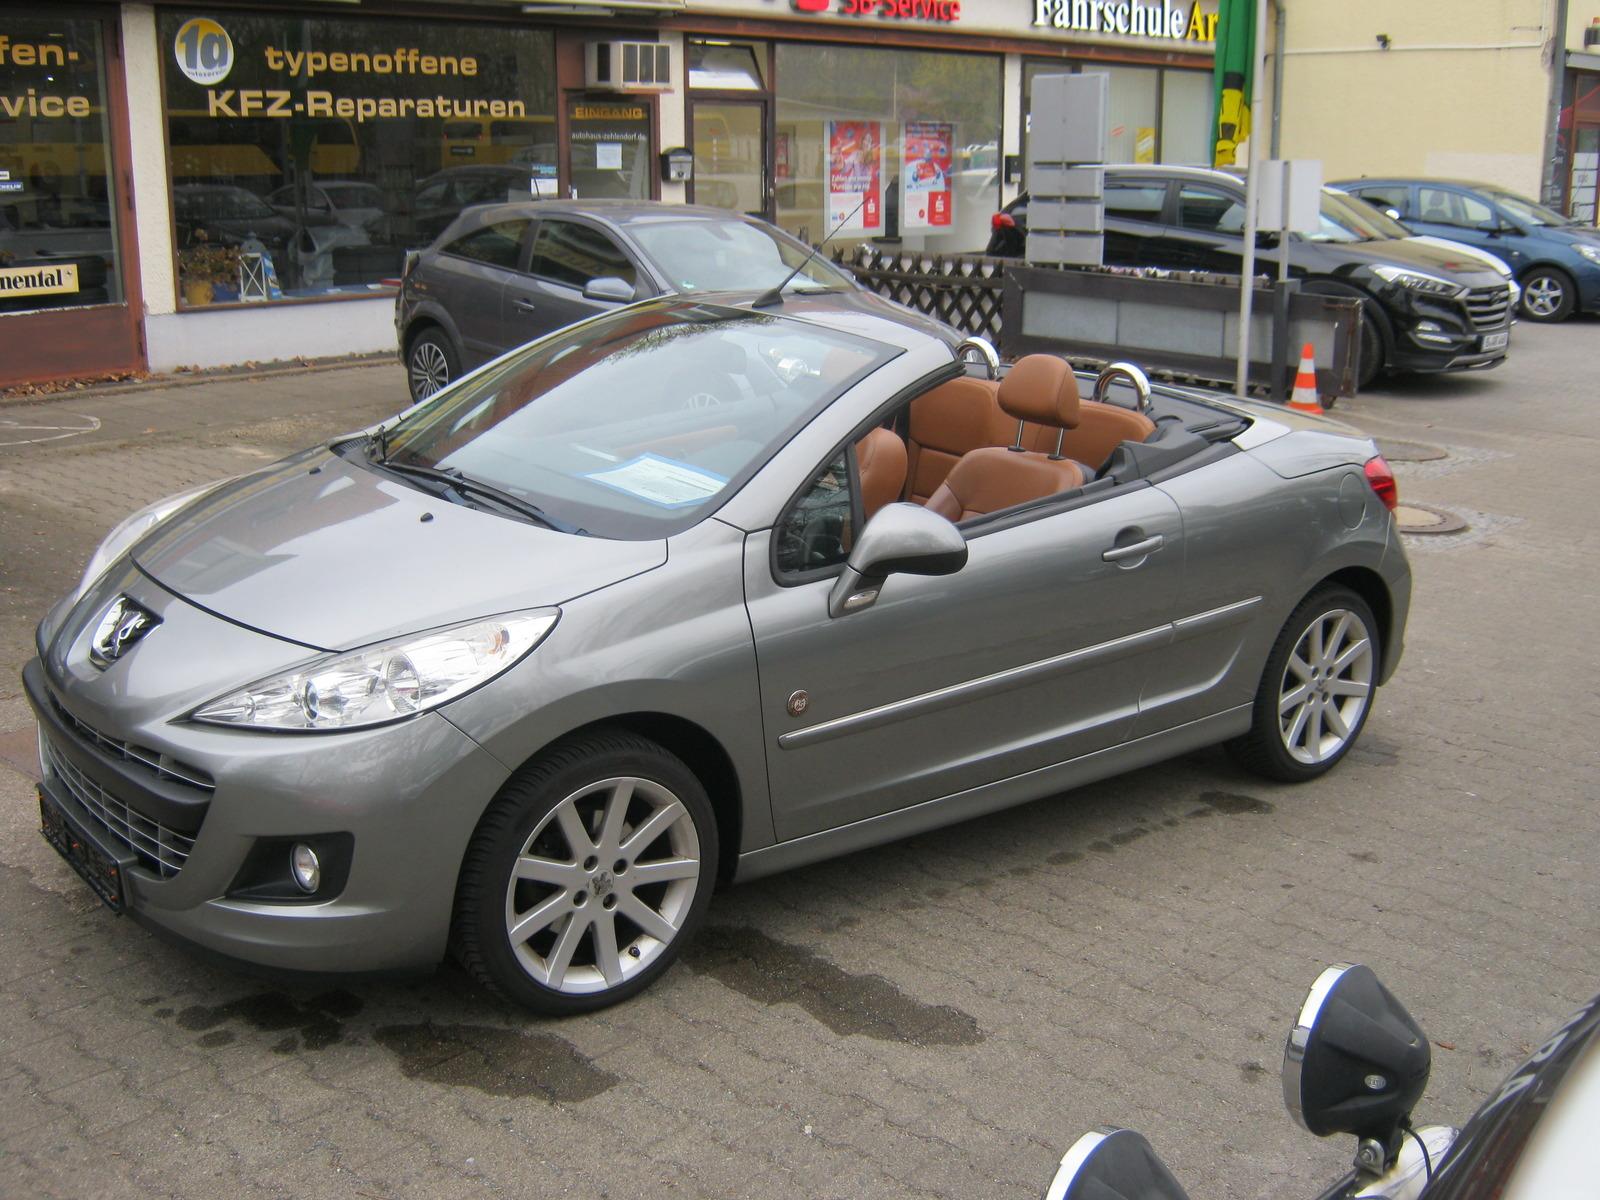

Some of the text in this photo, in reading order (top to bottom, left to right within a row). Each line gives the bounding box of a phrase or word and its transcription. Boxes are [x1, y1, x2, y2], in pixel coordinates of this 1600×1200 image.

[842, 0, 961, 21] SB-Service
[1034, 0, 1184, 39] Fahrschule
[265, 46, 478, 76] typenoffene
[207, 89, 526, 122] KFZ-Reparaturen
[575, 107, 643, 119] EINGANG
[571, 131, 646, 141] autohaus-zehlendorf.de
